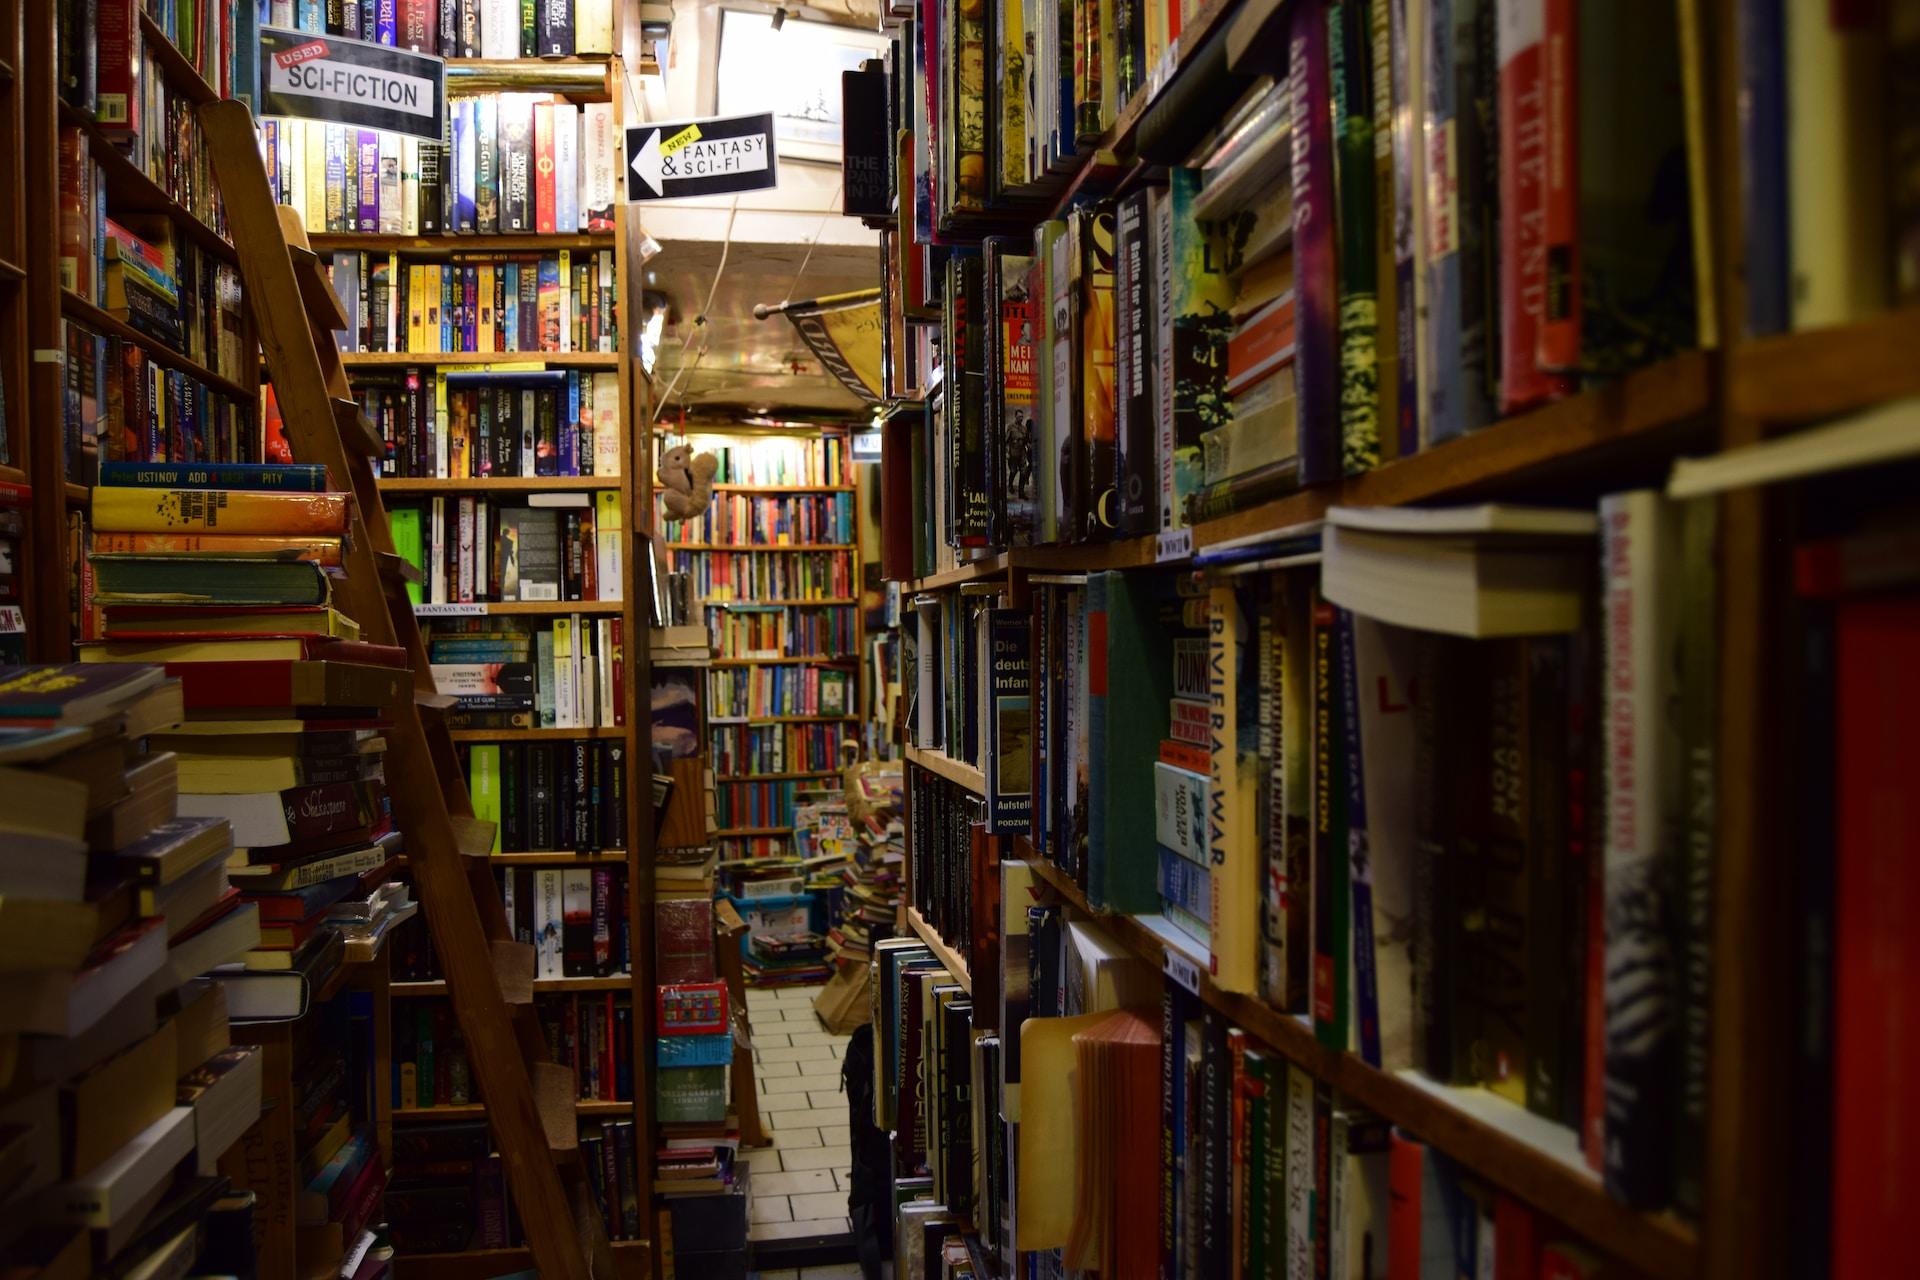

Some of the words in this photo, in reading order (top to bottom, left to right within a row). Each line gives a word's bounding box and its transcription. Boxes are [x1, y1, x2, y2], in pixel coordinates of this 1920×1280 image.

[416, 10, 425, 40] FEAST
[523, 3, 534, 30] FELL
[281, 44, 323, 65] USED
[288, 65, 417, 107] SCI-FICTION
[667, 131, 693, 151] NEW
[683, 136, 766, 160] FANTASY
[480, 151, 490, 182] GATES
[511, 152, 520, 202] MIDNIGHT
[519, 154, 527, 194] TOWERS
[661, 155, 678, 177] &
[684, 156, 741, 176] SCI-FI
[1131, 240, 1141, 284] Battle
[1161, 212, 1170, 274] SANDRA
[520, 269, 530, 303] BAXTER
[1133, 286, 1142, 304] for
[1161, 278, 1171, 328] GWYN
[955, 296, 967, 369] NAZIS
[1134, 309, 1142, 330] the
[1134, 333, 1144, 398] RUHR
[1161, 346, 1171, 426] TAPESTRY
[953, 383, 961, 441] LAURENCE
[1162, 431, 1171, 449] OF
[137, 471, 178, 483] USTINOV
[187, 472, 208, 483] ADD
[262, 472, 284, 483] PITY
[1162, 458, 1171, 494] WAR
[1164, 539, 1183, 553] WWII
[459, 605, 477, 613] NEW
[996, 640, 1017, 653] Die
[1259, 627, 1272, 690] BRIDGE
[995, 676, 1029, 689] Infan
[1067, 613, 1075, 732] FORGOTTEN
[1211, 618, 1225, 753] RIVIERA
[1318, 632, 1330, 701] D-DAY
[1259, 694, 1272, 725] TOO
[1270, 639, 1283, 770] TRADITIONAL
[1259, 728, 1272, 757] FAR
[1317, 704, 1330, 834] DECEPTION
[998, 819, 1030, 827] PODZUN
[1180, 783, 1188, 847] BEEVOR
[1210, 789, 1226, 866] WAR
[1270, 775, 1284, 862] ENEMIES
[1163, 992, 1174, 1041] THOSE
[1163, 1044, 1174, 1078] WHO
[1163, 1080, 1174, 1113] FALL
[1204, 1062, 1216, 1127] QUIET
[1263, 1072, 1273, 1246] INTERPRETER
[1271, 1145, 1283, 1182] THE
[1203, 1137, 1216, 1249] AMERICAN
